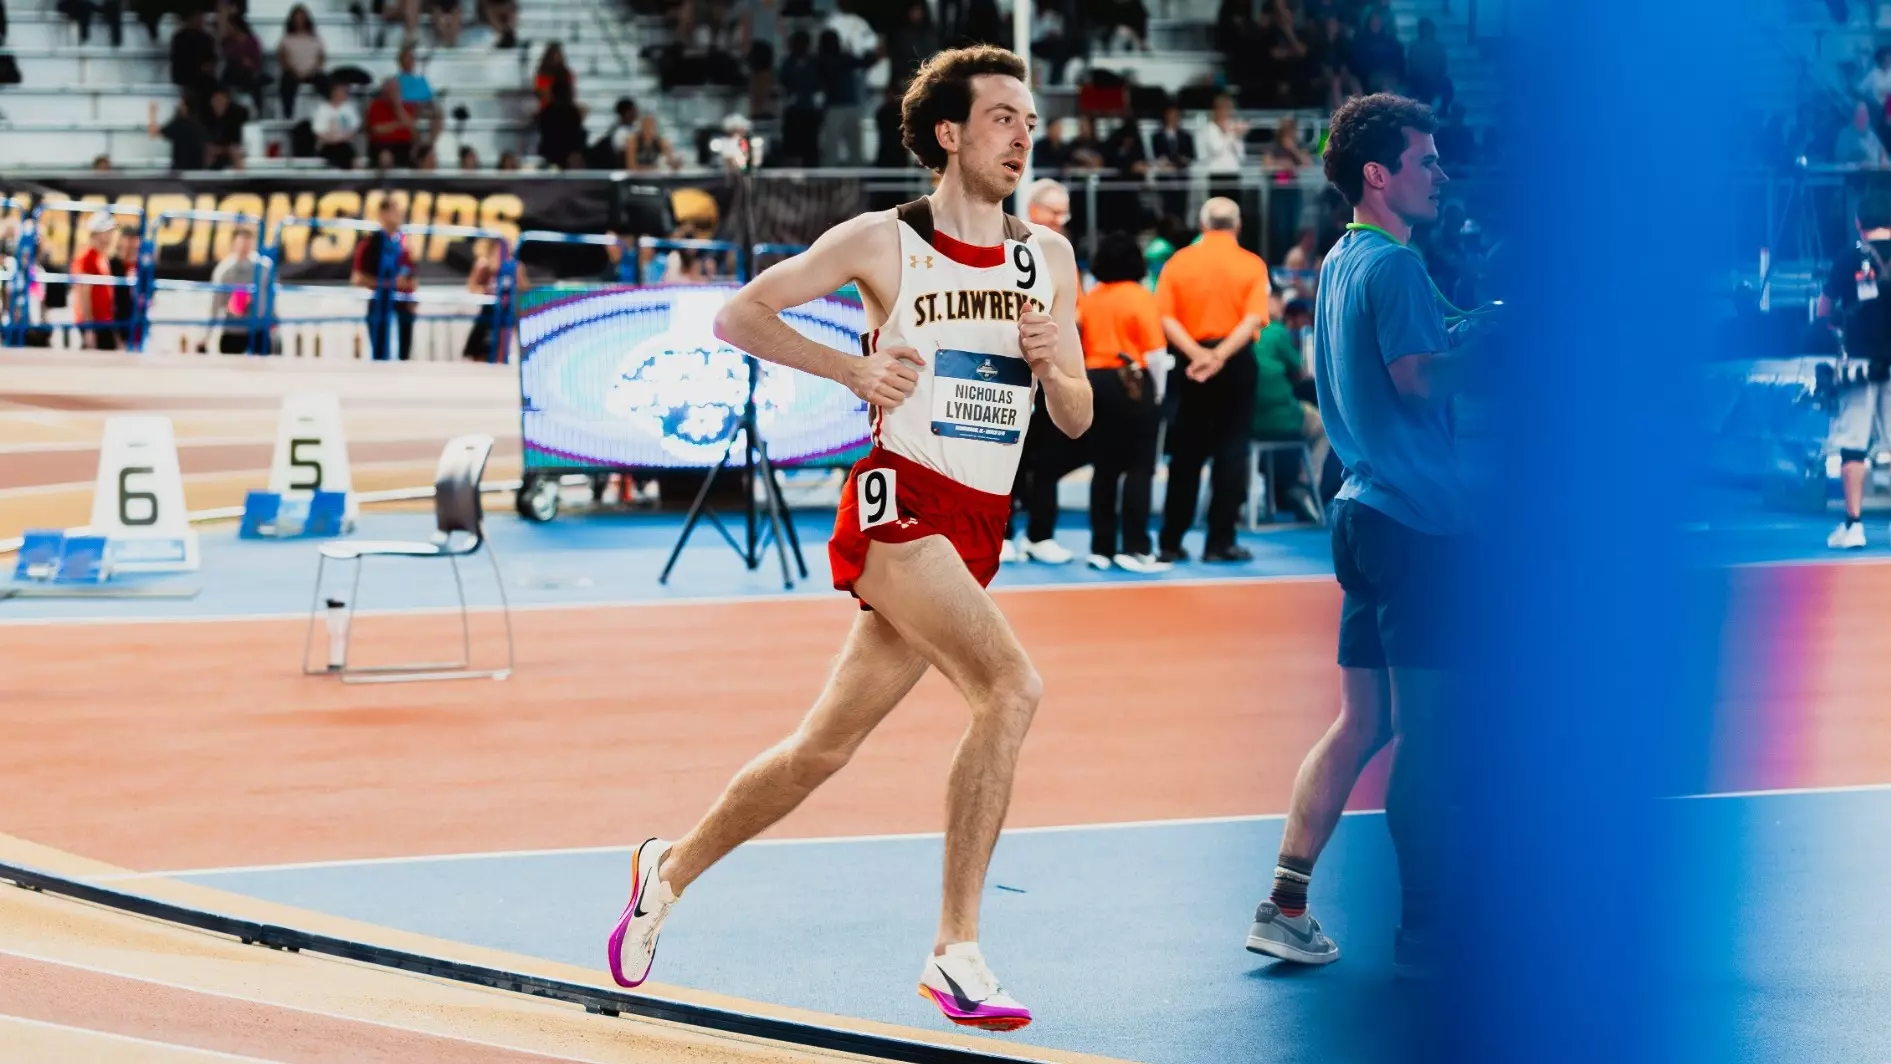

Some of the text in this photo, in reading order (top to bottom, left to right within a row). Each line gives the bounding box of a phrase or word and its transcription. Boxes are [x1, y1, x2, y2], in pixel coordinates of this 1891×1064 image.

[0, 190, 524, 266] APIONSIPS
[1013, 244, 1037, 290] 9
[913, 293, 943, 328] ST.
[945, 401, 1018, 426] LYNDAKER
[955, 384, 1014, 405] NICHOLAS
[288, 438, 323, 490] 5
[118, 466, 159, 526] 6
[864, 471, 888, 524] 9
